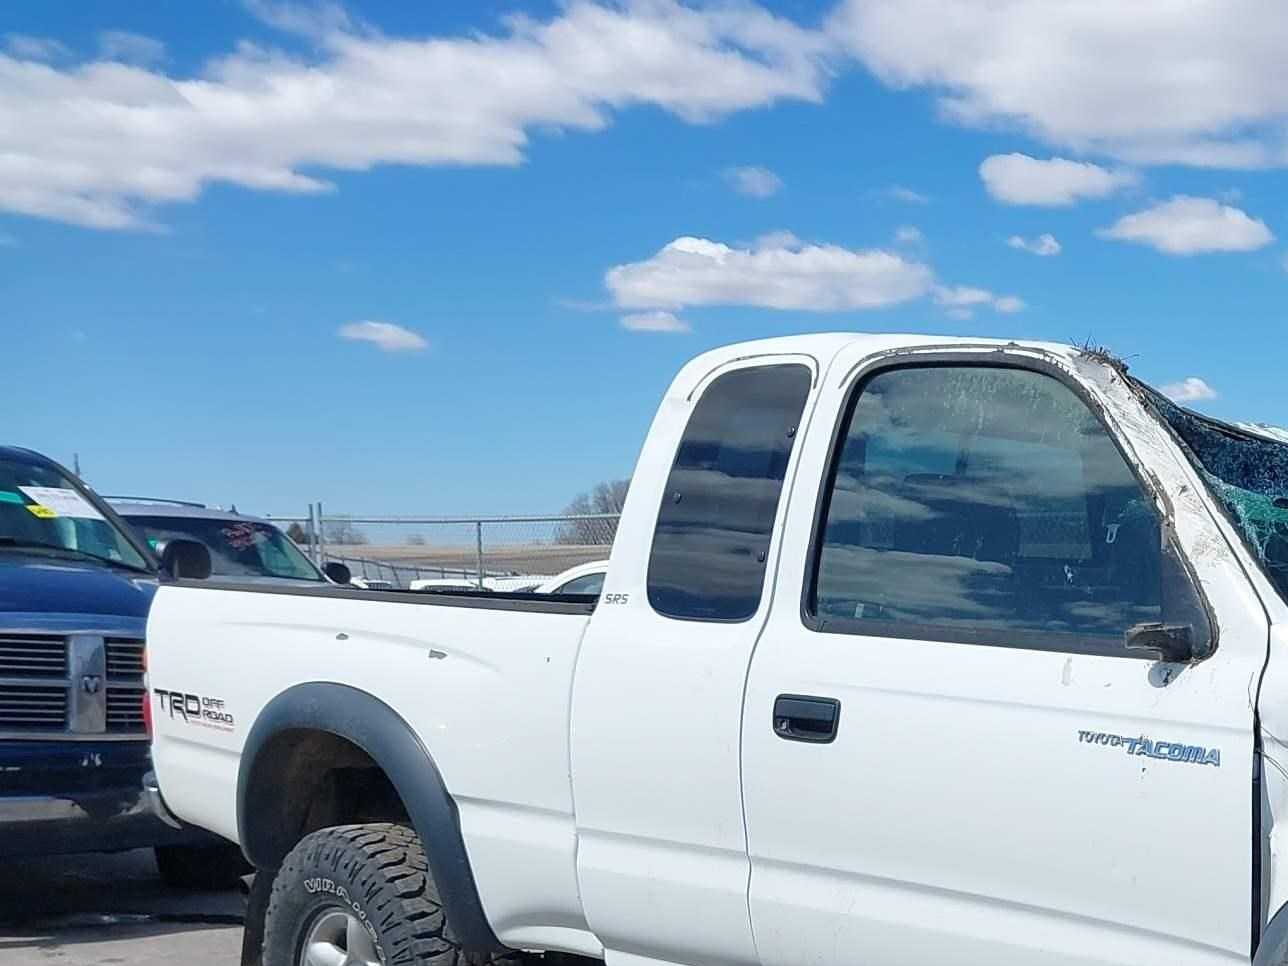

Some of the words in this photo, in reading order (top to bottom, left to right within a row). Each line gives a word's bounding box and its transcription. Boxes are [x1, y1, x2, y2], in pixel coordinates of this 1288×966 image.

[154, 688, 201, 723] TRD
[202, 697, 225, 707] OFF
[202, 709, 234, 723] ROAD
[1123, 736, 1221, 766] TACOMA
